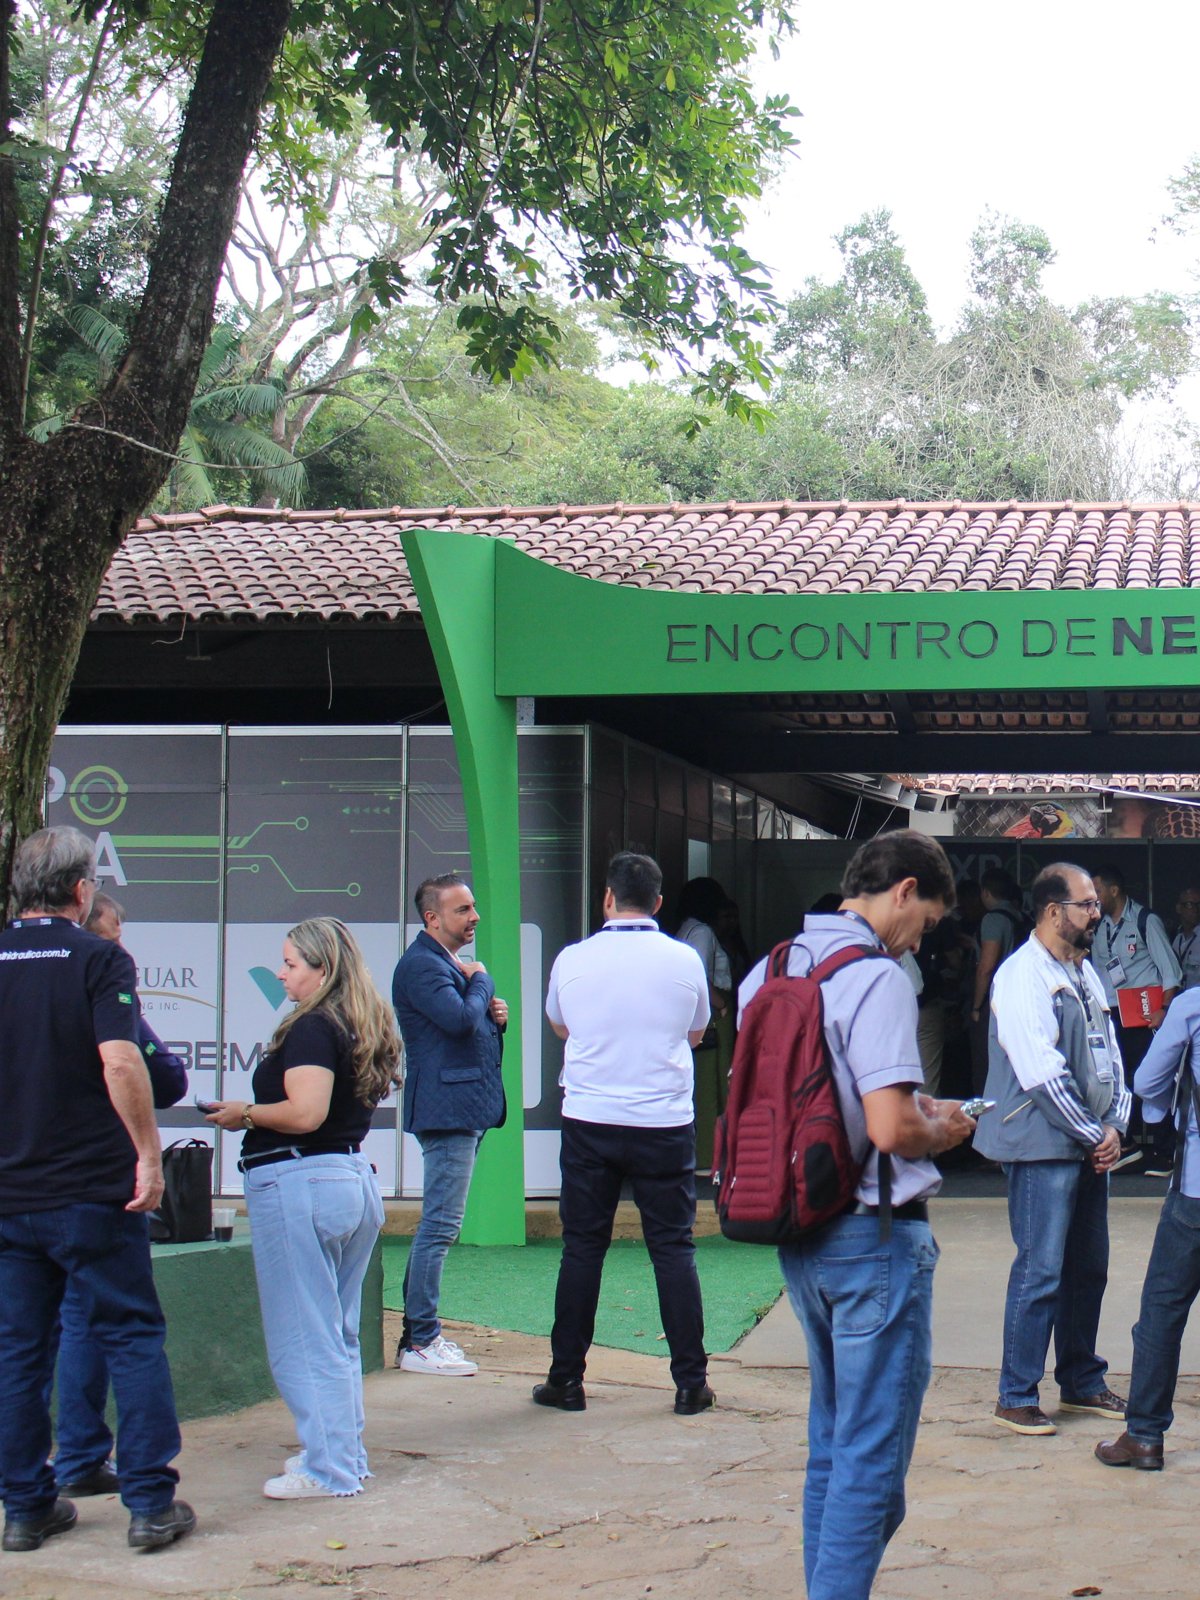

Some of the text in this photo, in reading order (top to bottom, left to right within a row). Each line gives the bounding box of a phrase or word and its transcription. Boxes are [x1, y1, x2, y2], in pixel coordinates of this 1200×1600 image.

[666, 620, 998, 662] ENCONTRO
[1022, 618, 1096, 657] DE
[1140, 990, 1152, 1022] NDRA
